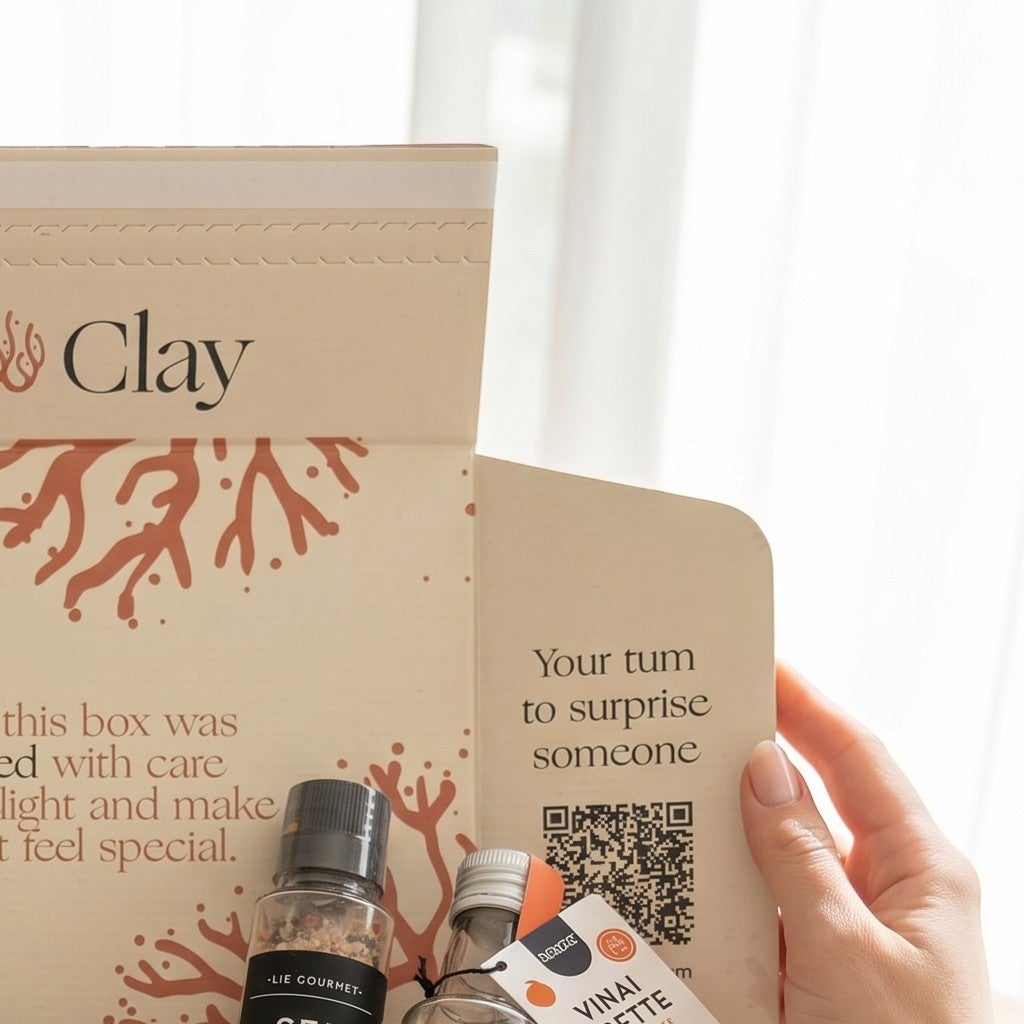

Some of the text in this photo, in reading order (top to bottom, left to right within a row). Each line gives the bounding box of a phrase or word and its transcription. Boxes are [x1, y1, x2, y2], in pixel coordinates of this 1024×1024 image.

[62, 309, 254, 410] Clay
[532, 648, 612, 679] Your
[2, 702, 67, 738] this
[81, 702, 152, 738] box
[163, 713, 238, 738] was
[522, 689, 712, 730] to surprise
[51, 745, 132, 779] with
[146, 753, 228, 779] care
[533, 740, 702, 770] someone
[89, 786, 159, 821] and
[173, 786, 279, 821] make
[23, 827, 85, 863] feel
[99, 827, 237, 873] special.
[572, 975, 643, 1021] VINAI
